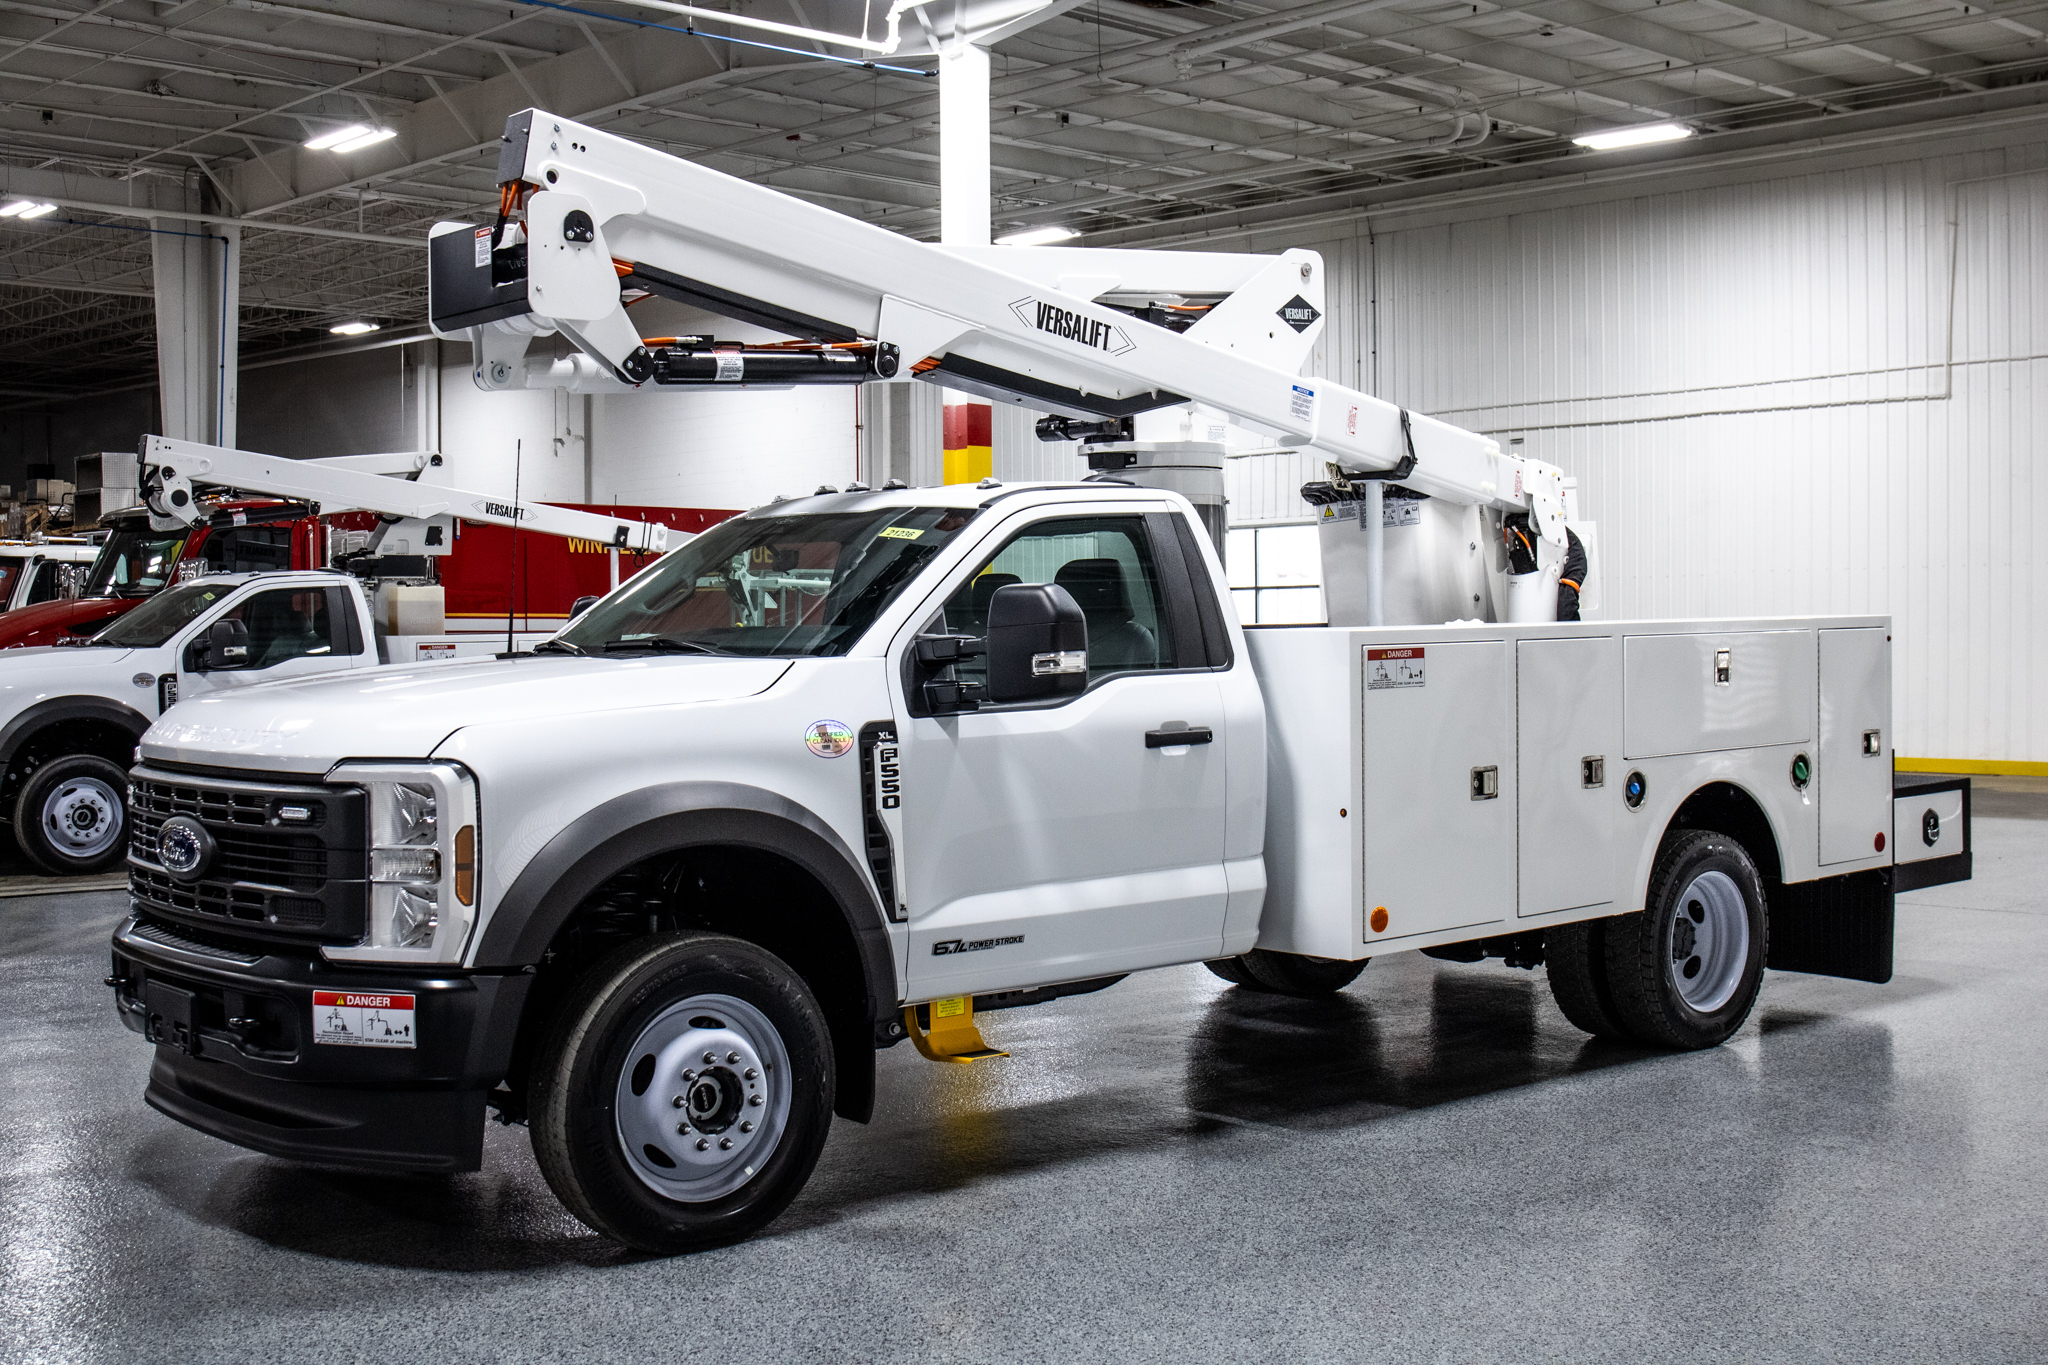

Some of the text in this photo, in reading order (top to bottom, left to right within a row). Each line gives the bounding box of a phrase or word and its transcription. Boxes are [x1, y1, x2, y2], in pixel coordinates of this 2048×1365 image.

[1285, 308, 1311, 320] VERSALIFT
[1036, 301, 1111, 351] VERSALIFT
[485, 501, 525, 520] VERSALIFT
[1387, 650, 1412, 658] DANGER
[878, 731, 893, 739] XL
[880, 747, 900, 809] F550
[969, 940, 994, 949] POWER
[995, 936, 1023, 946] STROKE
[346, 995, 391, 1007] DANGER
